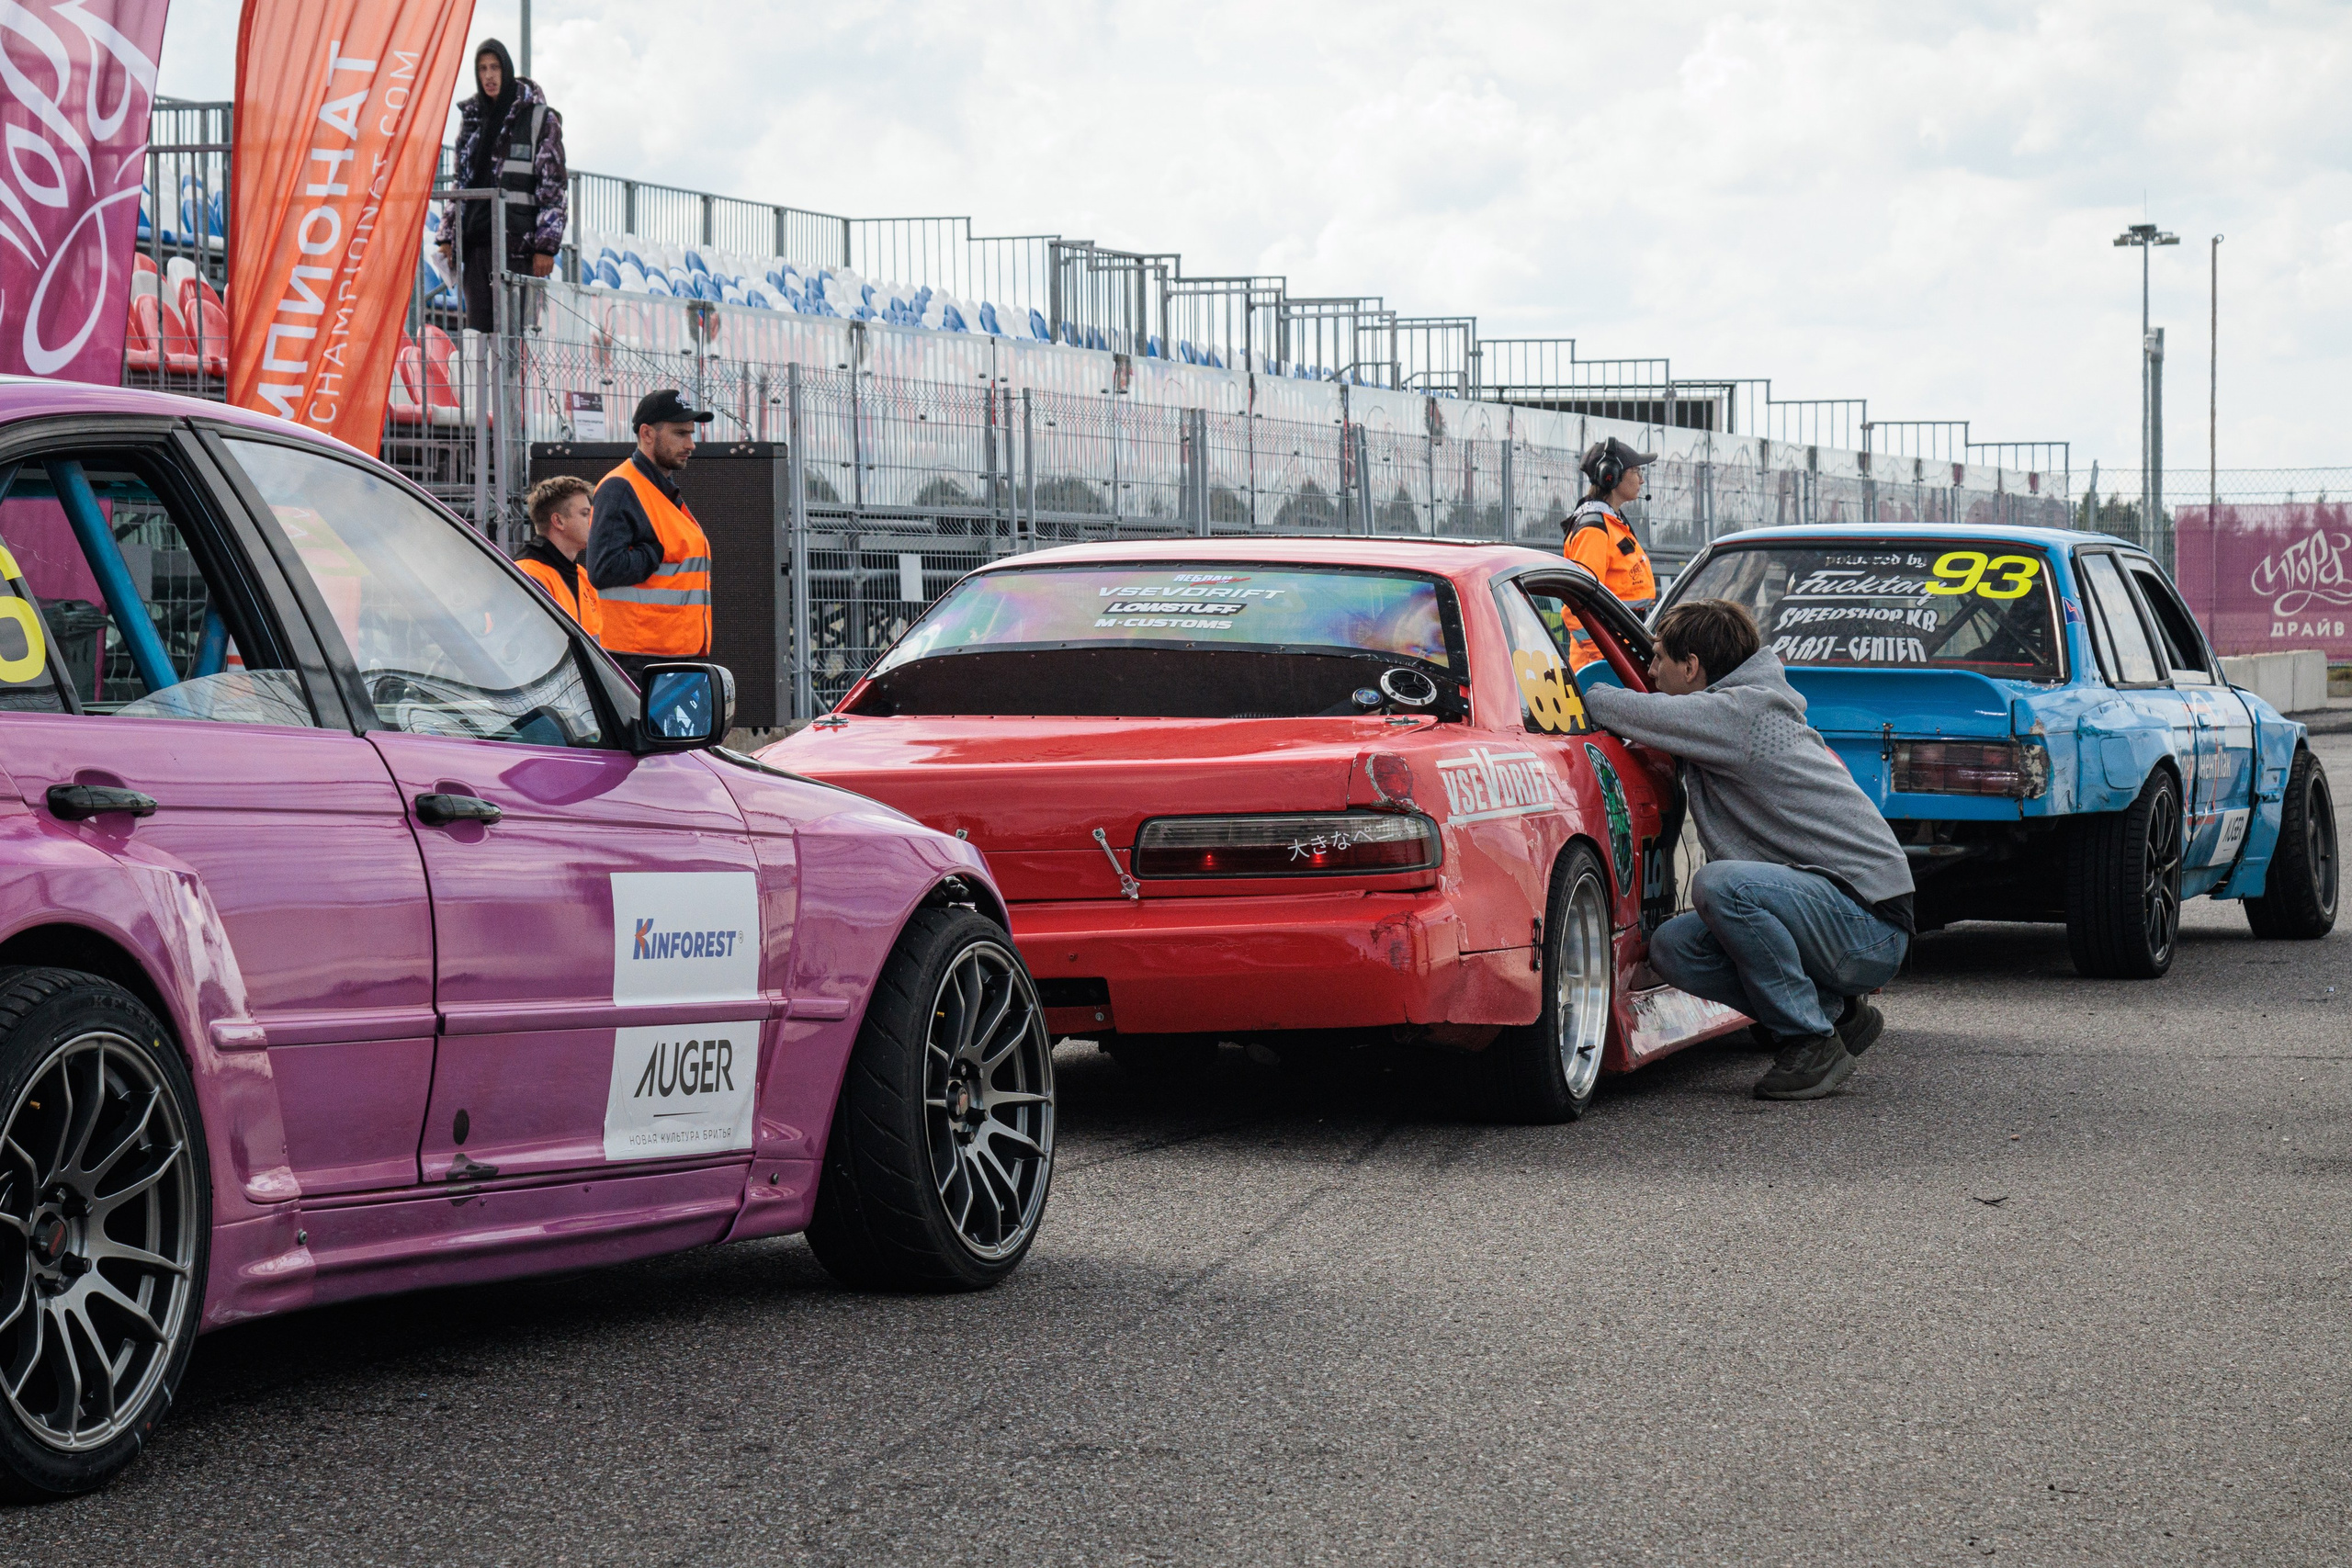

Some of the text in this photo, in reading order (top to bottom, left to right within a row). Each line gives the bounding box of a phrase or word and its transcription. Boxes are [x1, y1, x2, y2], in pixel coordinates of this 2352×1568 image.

[1925, 551, 2040, 599] 93
[1099, 587, 1286, 601] VSEVDRIFT
[1108, 603, 1241, 615] LOWSTUFF
[2270, 618, 2345, 637] ДРАЙВ
[1442, 748, 1554, 816] VSEVDRIFT
[629, 1127, 731, 1145] НОВАЯ КУЛЬТУРА БРИТЬЯ
